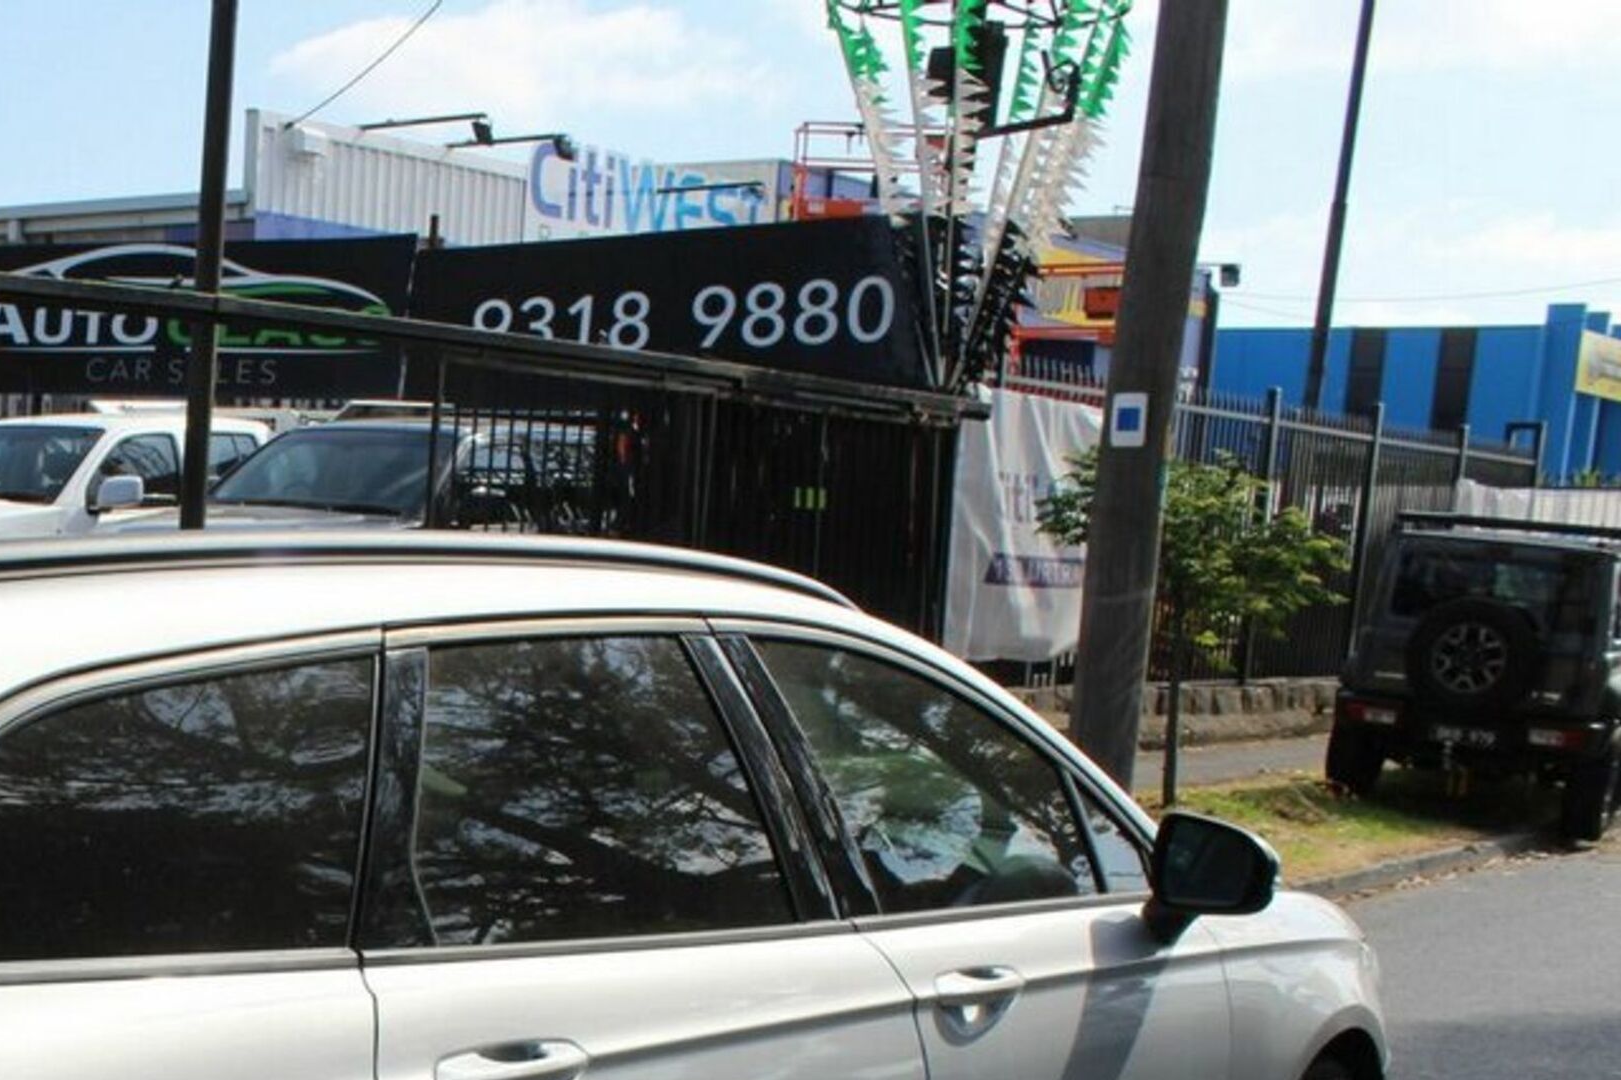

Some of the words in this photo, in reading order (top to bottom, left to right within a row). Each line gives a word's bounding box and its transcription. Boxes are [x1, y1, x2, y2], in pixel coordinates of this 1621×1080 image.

[473, 290, 650, 350] 9318
[692, 276, 896, 348] 9880
[85, 357, 151, 383] CAR
[167, 358, 277, 385] SLES
